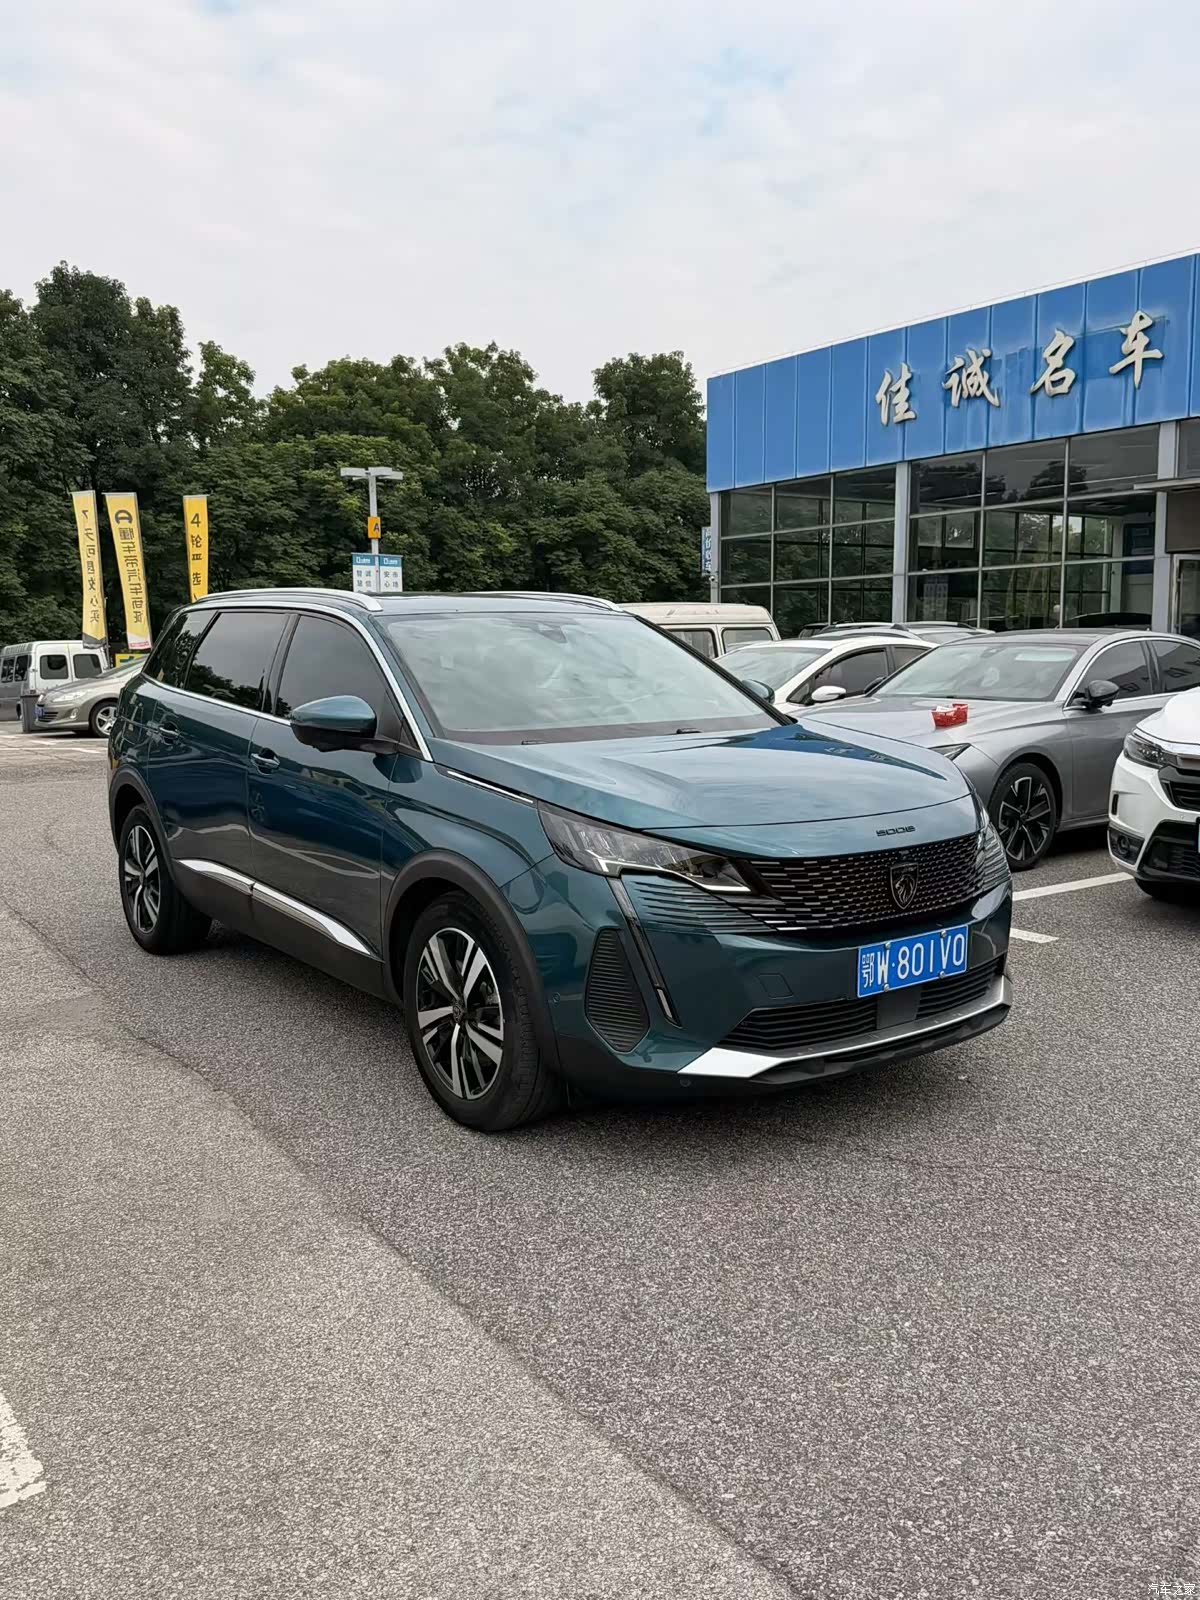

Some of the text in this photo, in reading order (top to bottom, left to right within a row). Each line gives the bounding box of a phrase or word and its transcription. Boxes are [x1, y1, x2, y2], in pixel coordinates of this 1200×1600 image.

[875, 309, 1164, 427] 佳诚名车
[190, 512, 202, 600] 4轮严选
[373, 522, 380, 532] A
